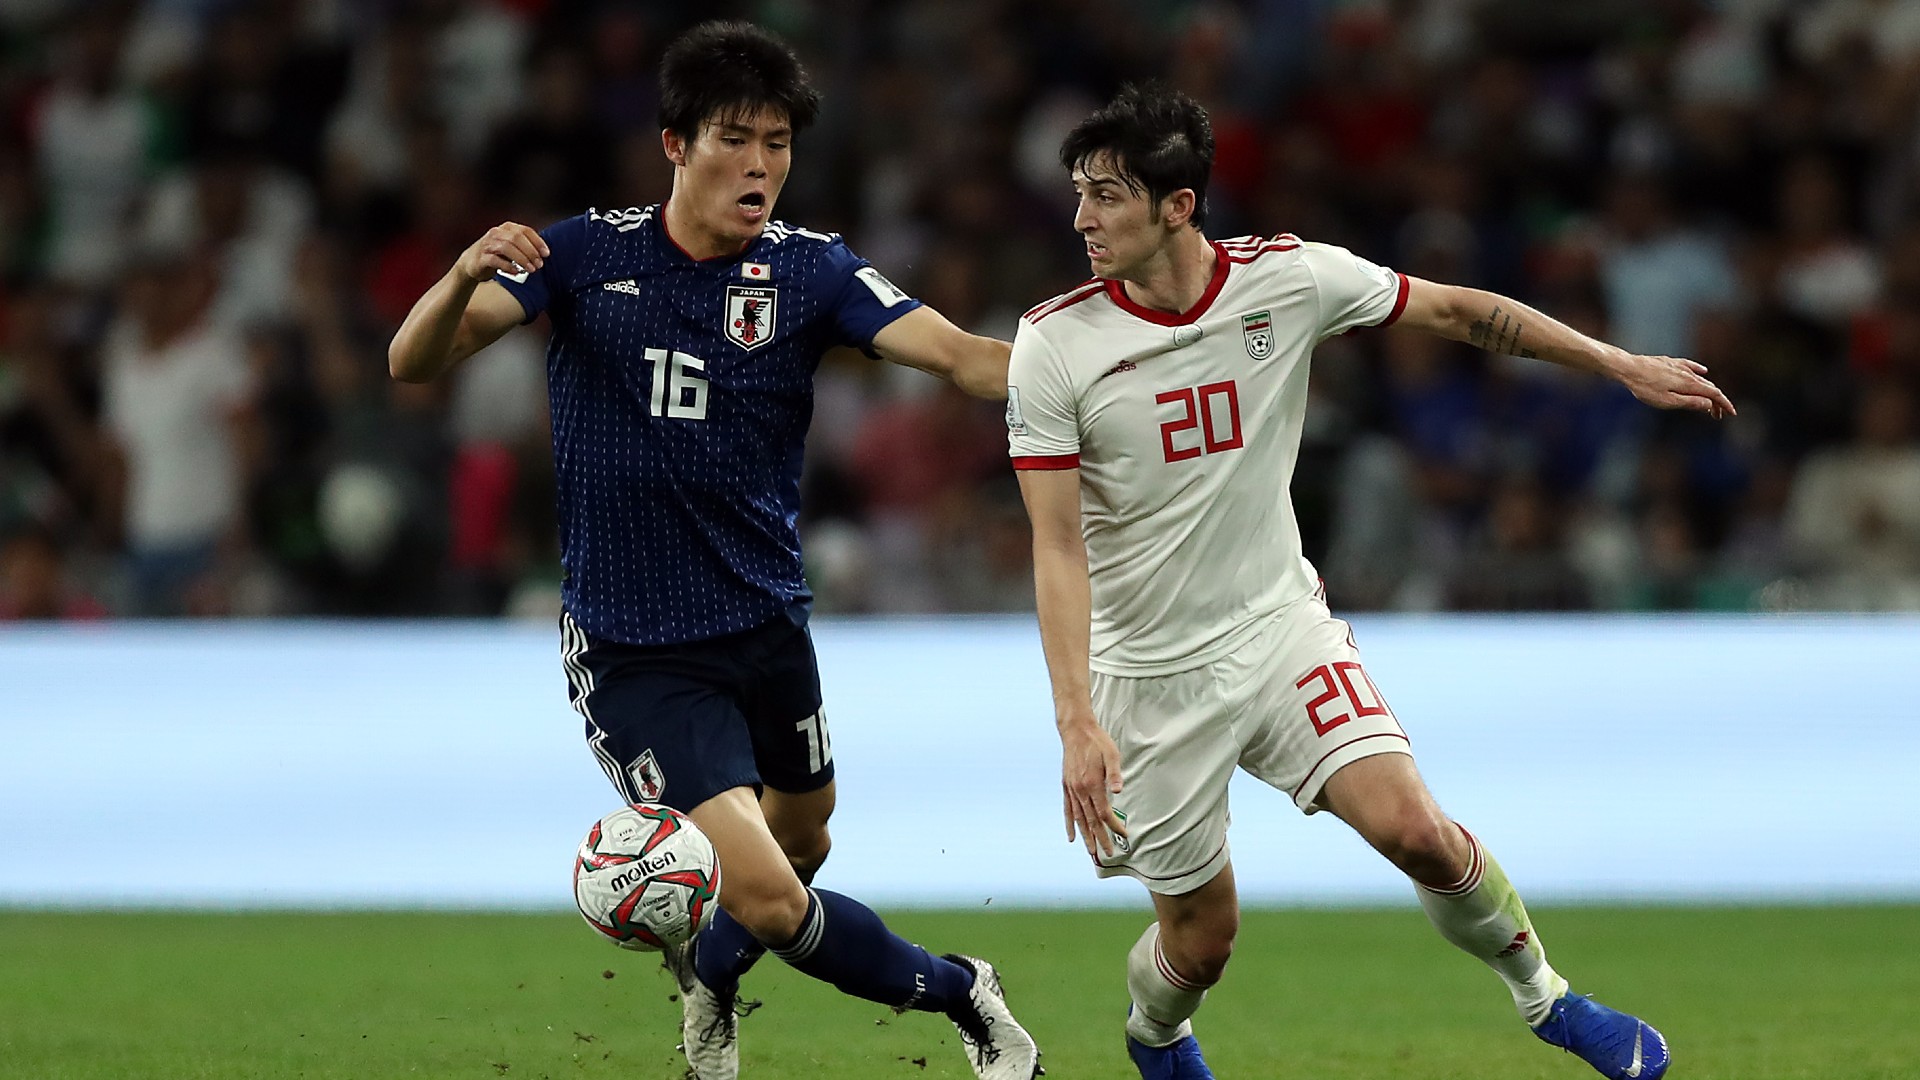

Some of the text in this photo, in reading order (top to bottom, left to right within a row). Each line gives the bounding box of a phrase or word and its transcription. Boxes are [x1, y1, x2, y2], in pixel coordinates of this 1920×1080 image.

[603, 281, 640, 296] adidas
[644, 348, 709, 420] 16
[1155, 380, 1244, 464] 20
[1295, 661, 1389, 738] 20
[611, 851, 677, 892] molten
